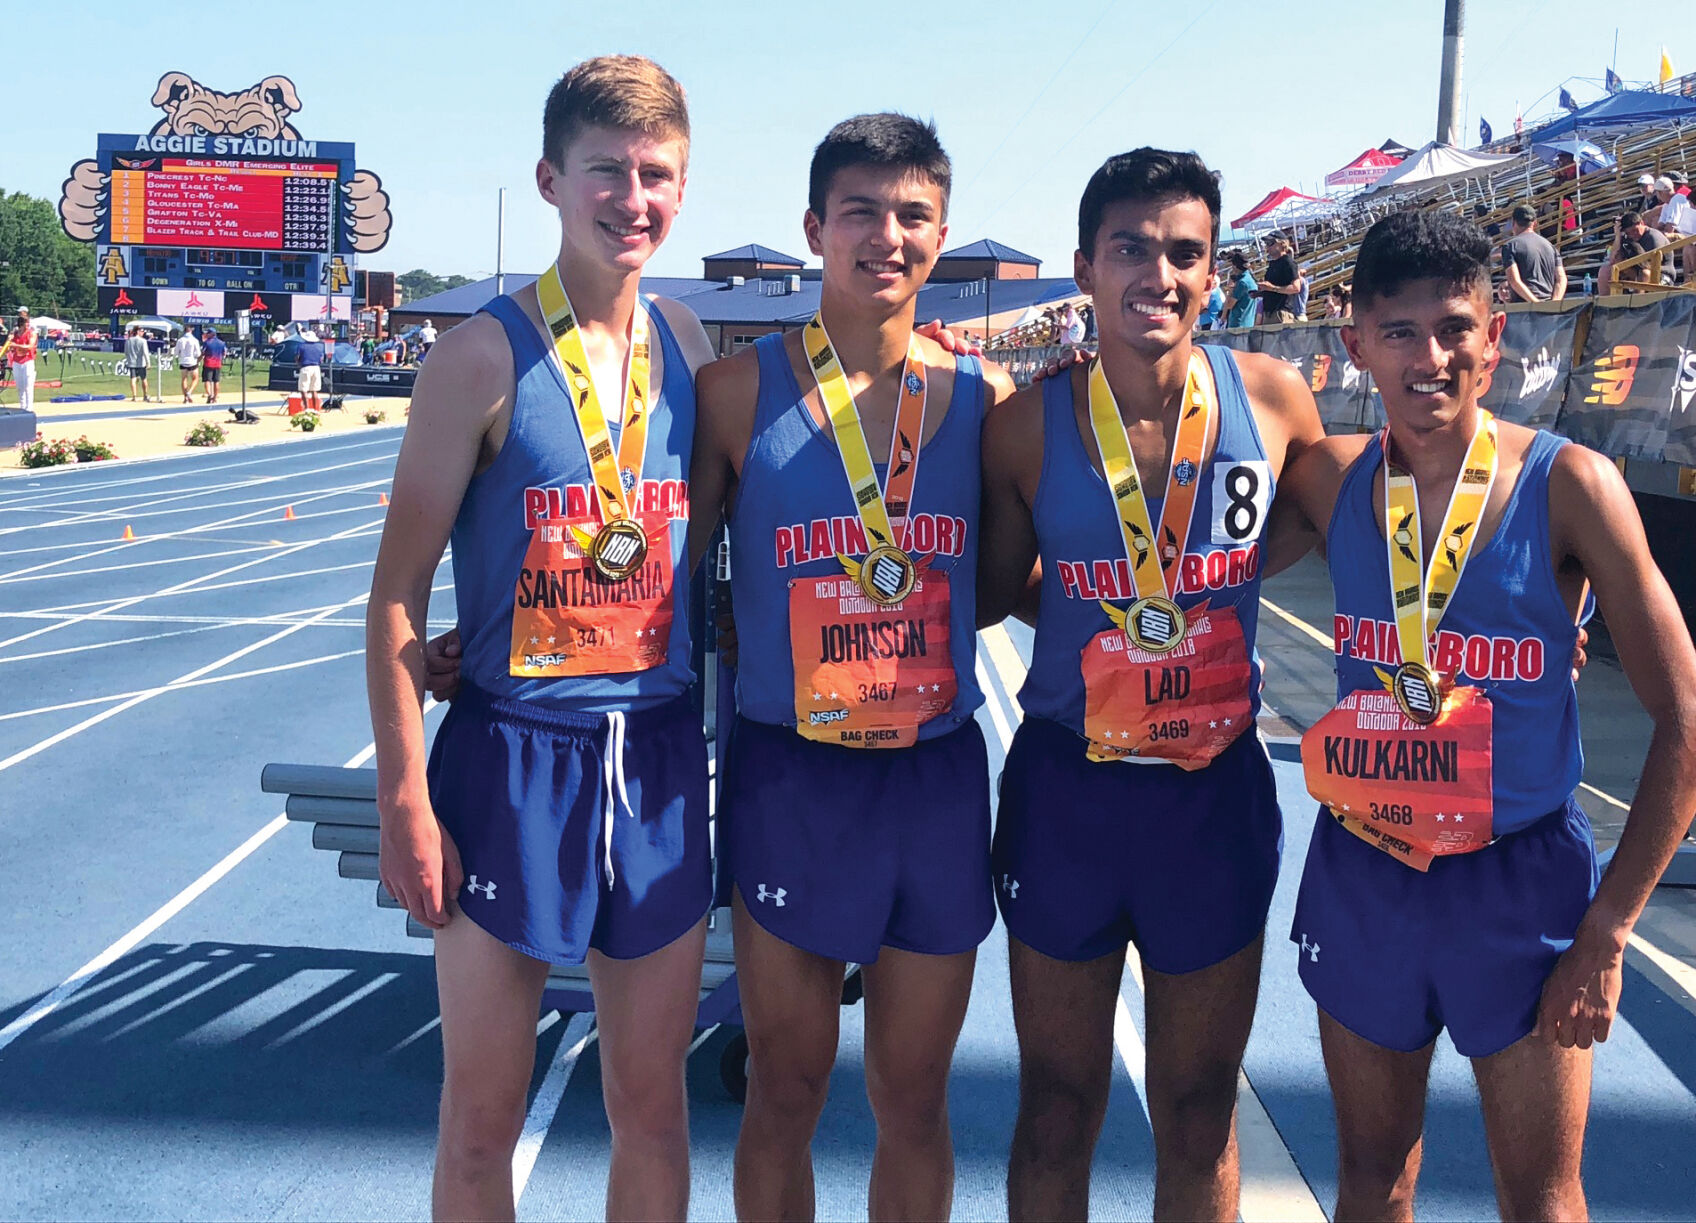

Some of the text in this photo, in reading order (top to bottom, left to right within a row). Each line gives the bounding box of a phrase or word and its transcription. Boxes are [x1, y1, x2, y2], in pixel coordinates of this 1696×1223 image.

[134, 136, 317, 158] AGGIE STADIUM
[290, 163, 314, 171] ELITE
[1224, 465, 1259, 540] 8
[518, 561, 666, 609] SANTAMARIA
[815, 582, 837, 599] NEW
[820, 619, 927, 664] JOHNSON
[1100, 635, 1124, 653] NEW
[1171, 638, 1196, 658] 2018
[525, 654, 568, 668] NSAF
[858, 682, 898, 703] 3467
[1144, 665, 1191, 706] LAD
[810, 709, 849, 722] NSAF
[841, 729, 899, 741] BAG CHECK
[1148, 719, 1190, 742] 3469
[1324, 736, 1458, 783] KULKARNI
[1369, 802, 1413, 826] 3468
[1382, 833, 1414, 856] CHECK
